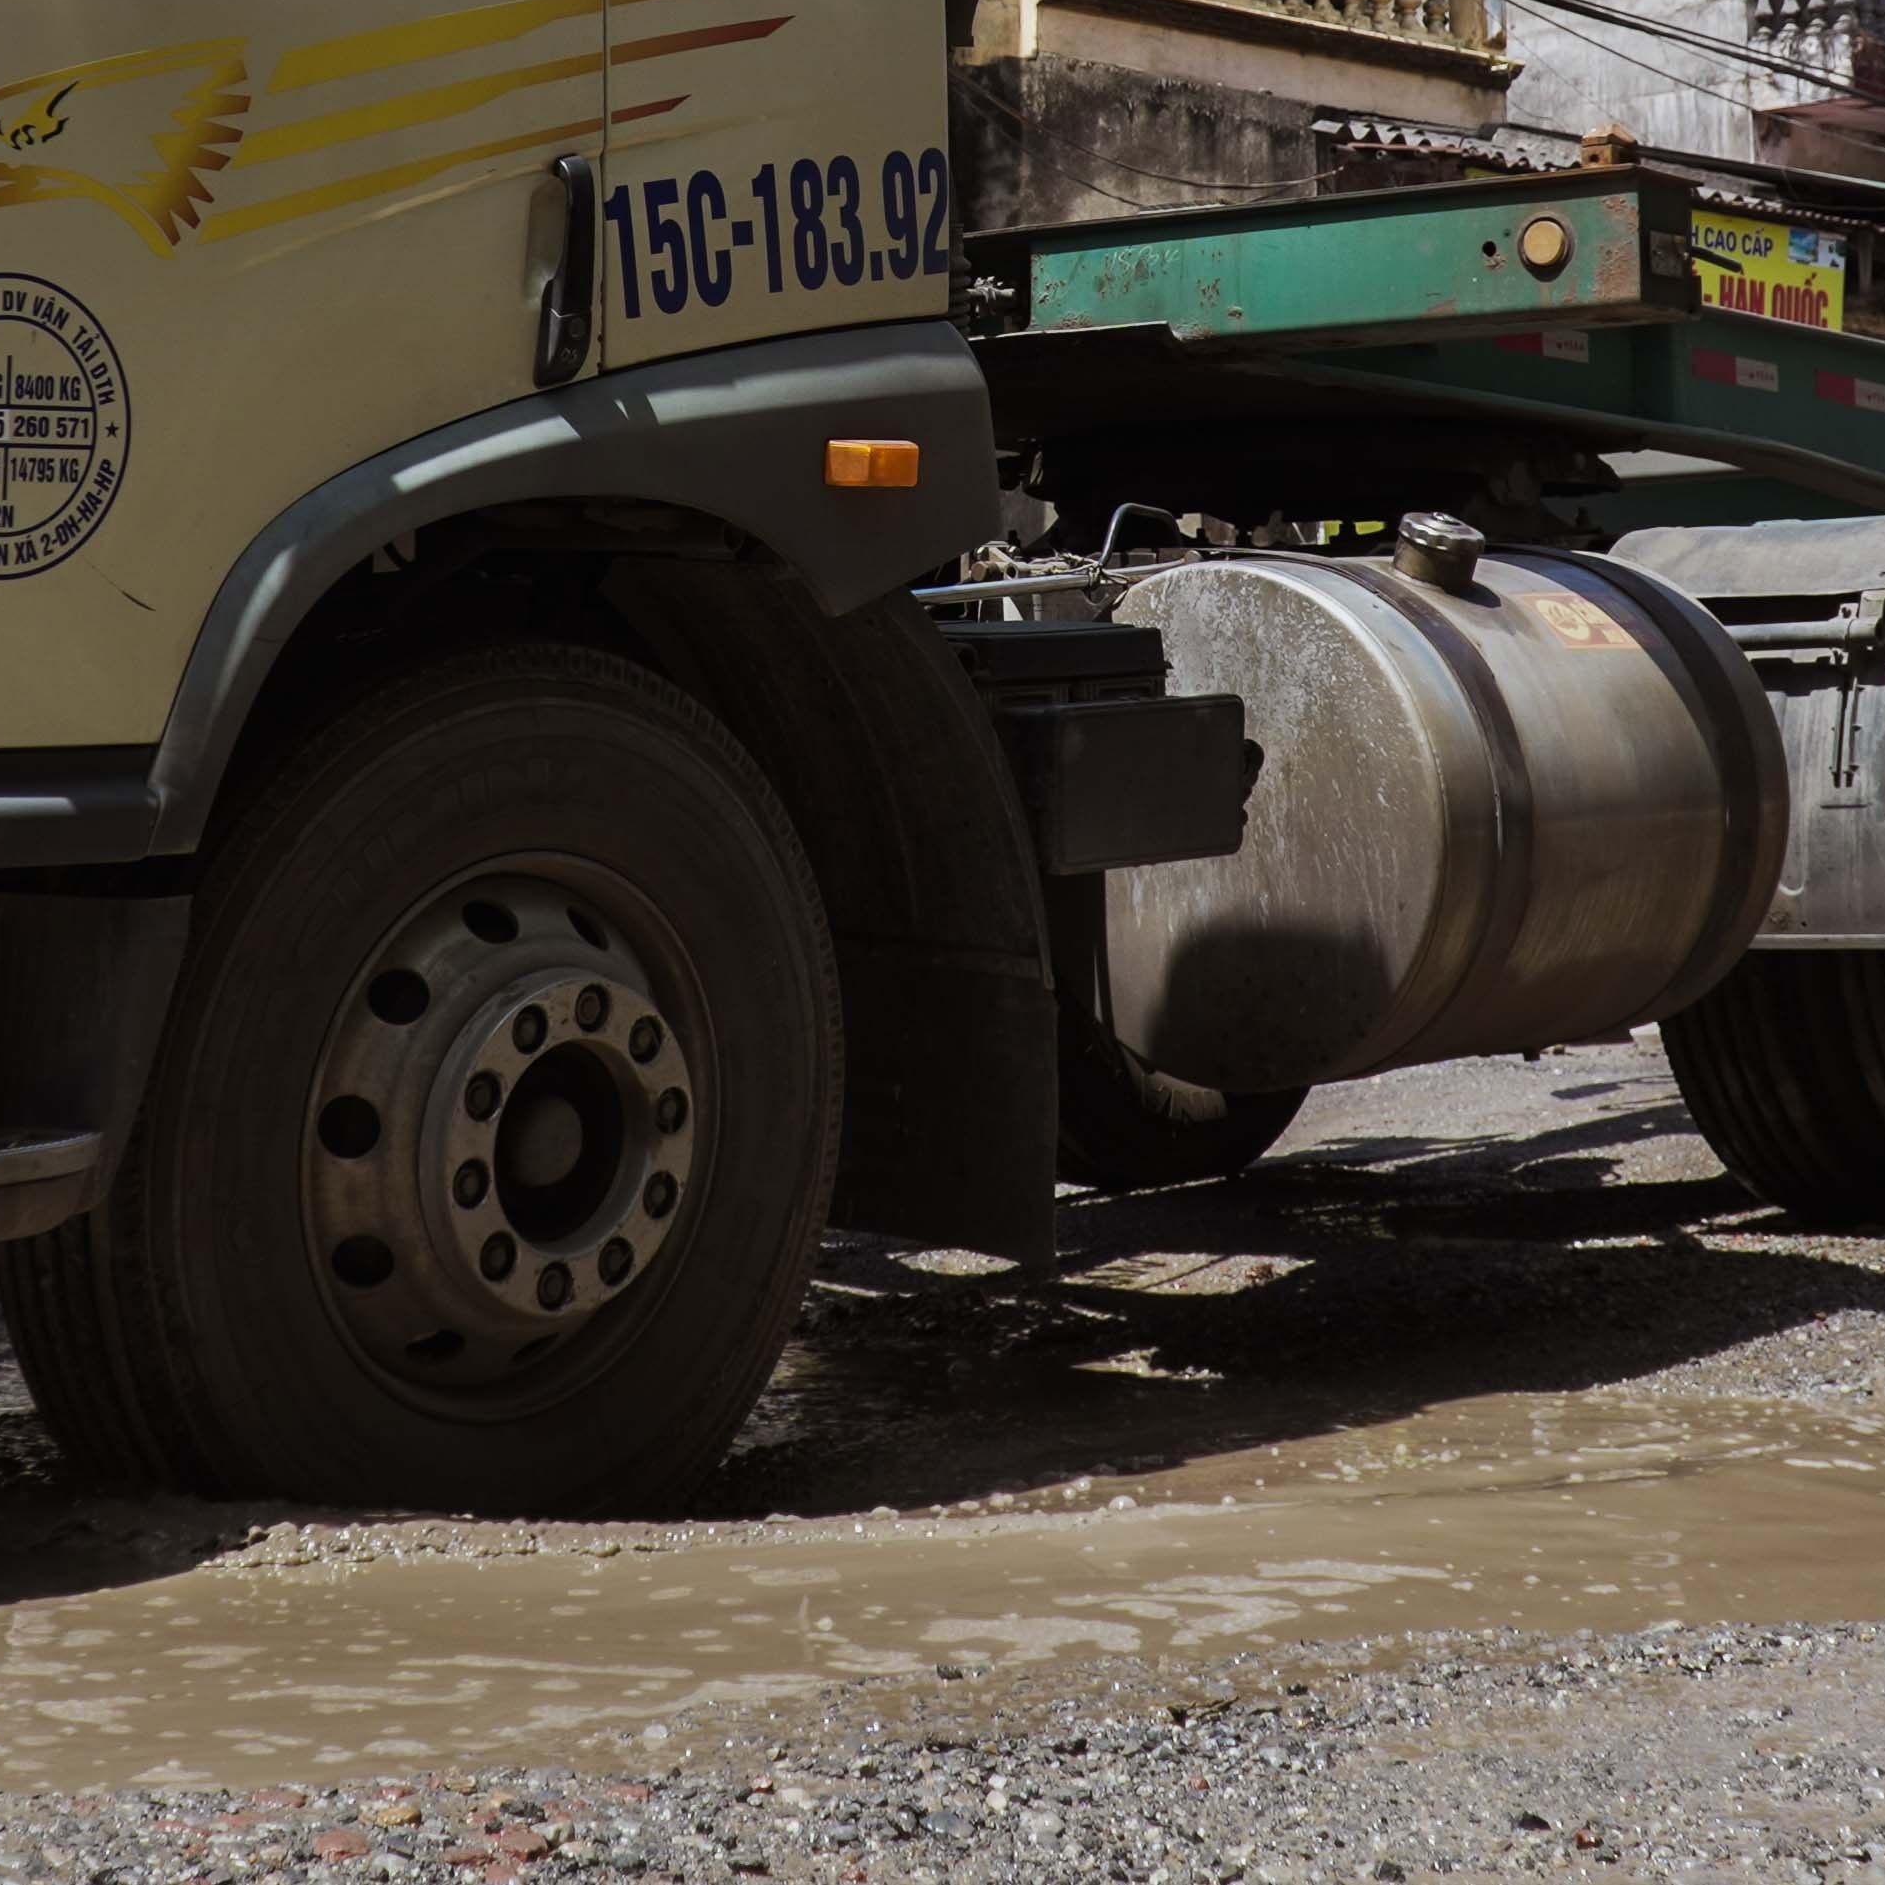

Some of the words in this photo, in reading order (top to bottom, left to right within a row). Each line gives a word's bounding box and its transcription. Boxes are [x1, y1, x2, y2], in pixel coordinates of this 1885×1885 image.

[604, 148, 949, 318] 15C-183.92
[1703, 229, 1737, 253] CAO
[1741, 226, 1774, 259] CẤP
[1720, 268, 1766, 315] HÀN
[3, 290, 28, 312] DV
[72, 325, 101, 363] TẢI
[91, 362, 117, 406] DTH
[15, 374, 54, 400] 8400
[59, 376, 81, 401] KG
[13, 416, 49, 438] 260
[56, 417, 90, 438] 571
[11, 457, 55, 483] 14795
[59, 458, 80, 484] KG
[14, 534, 38, 565] XÁ
